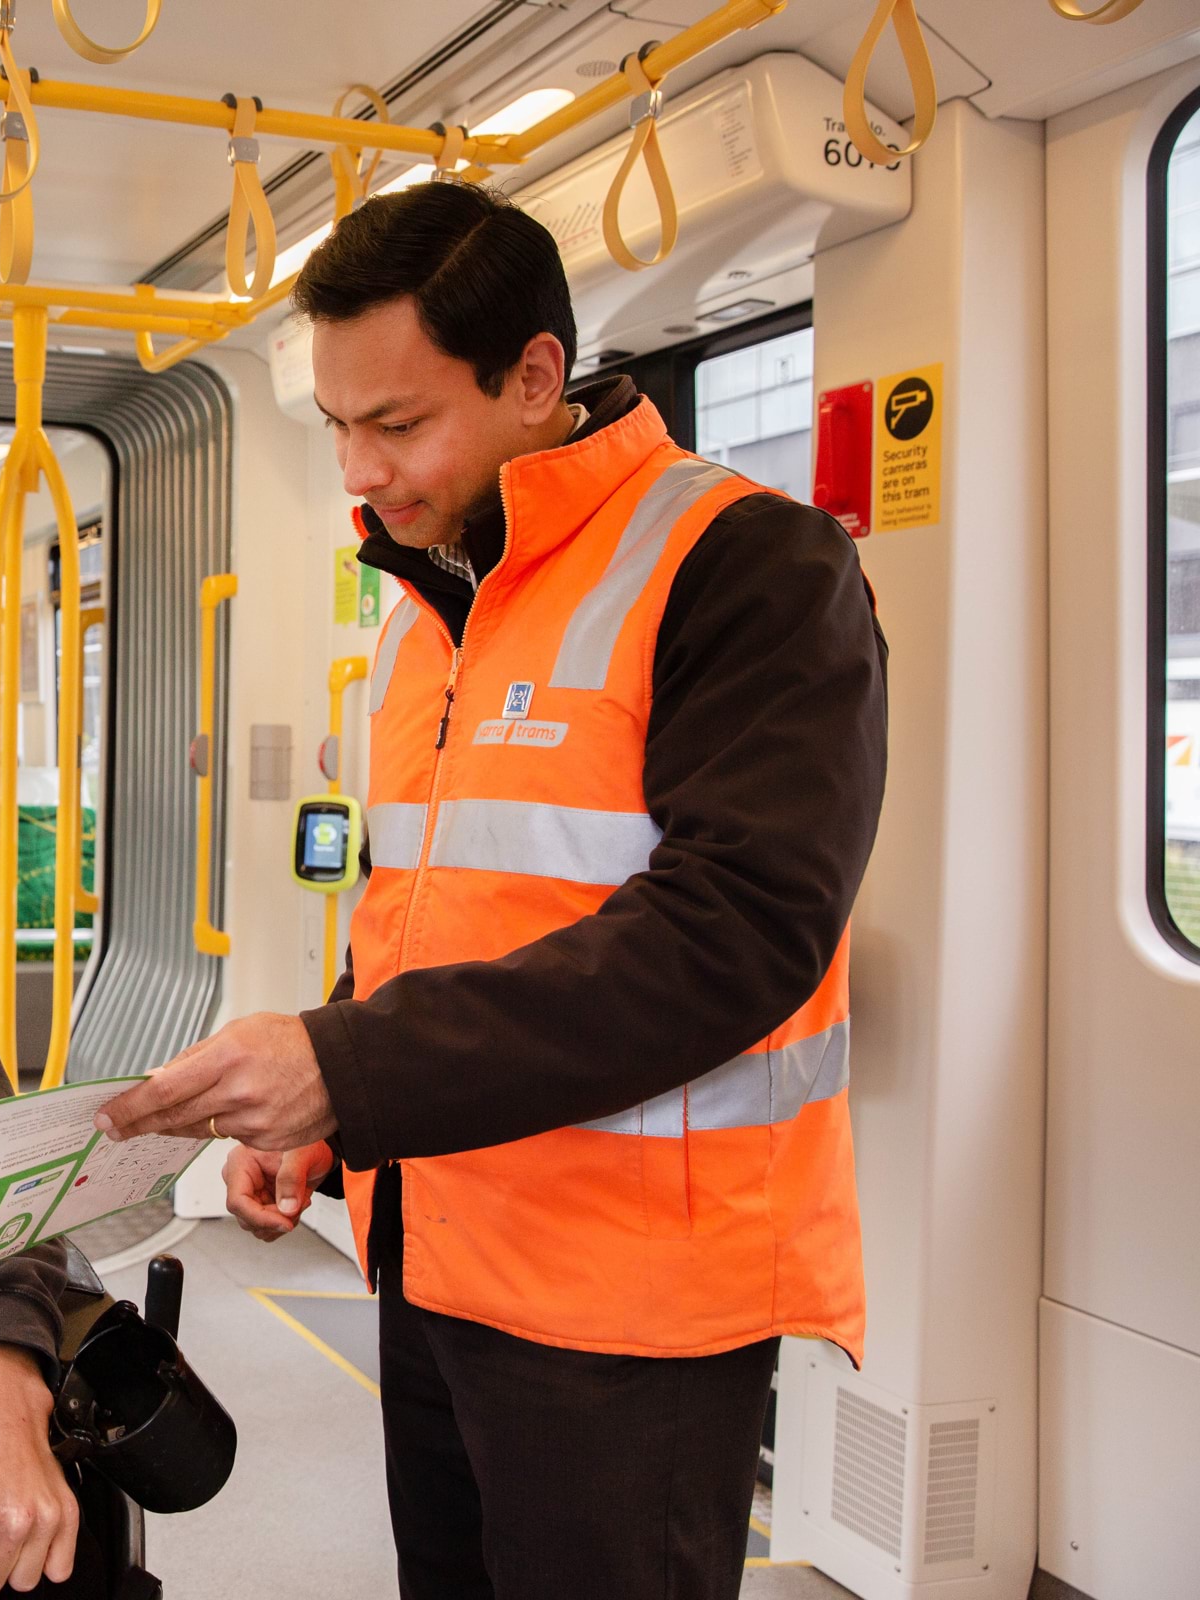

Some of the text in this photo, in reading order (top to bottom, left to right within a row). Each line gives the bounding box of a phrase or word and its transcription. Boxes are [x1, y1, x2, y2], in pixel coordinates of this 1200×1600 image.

[823, 117, 845, 132] Tra
[824, 139, 901, 171] 60
[883, 445, 928, 462] Security
[882, 461, 927, 477] cameras
[882, 476, 915, 489] are on
[882, 487, 929, 503] this tram
[516, 724, 557, 740] trams
